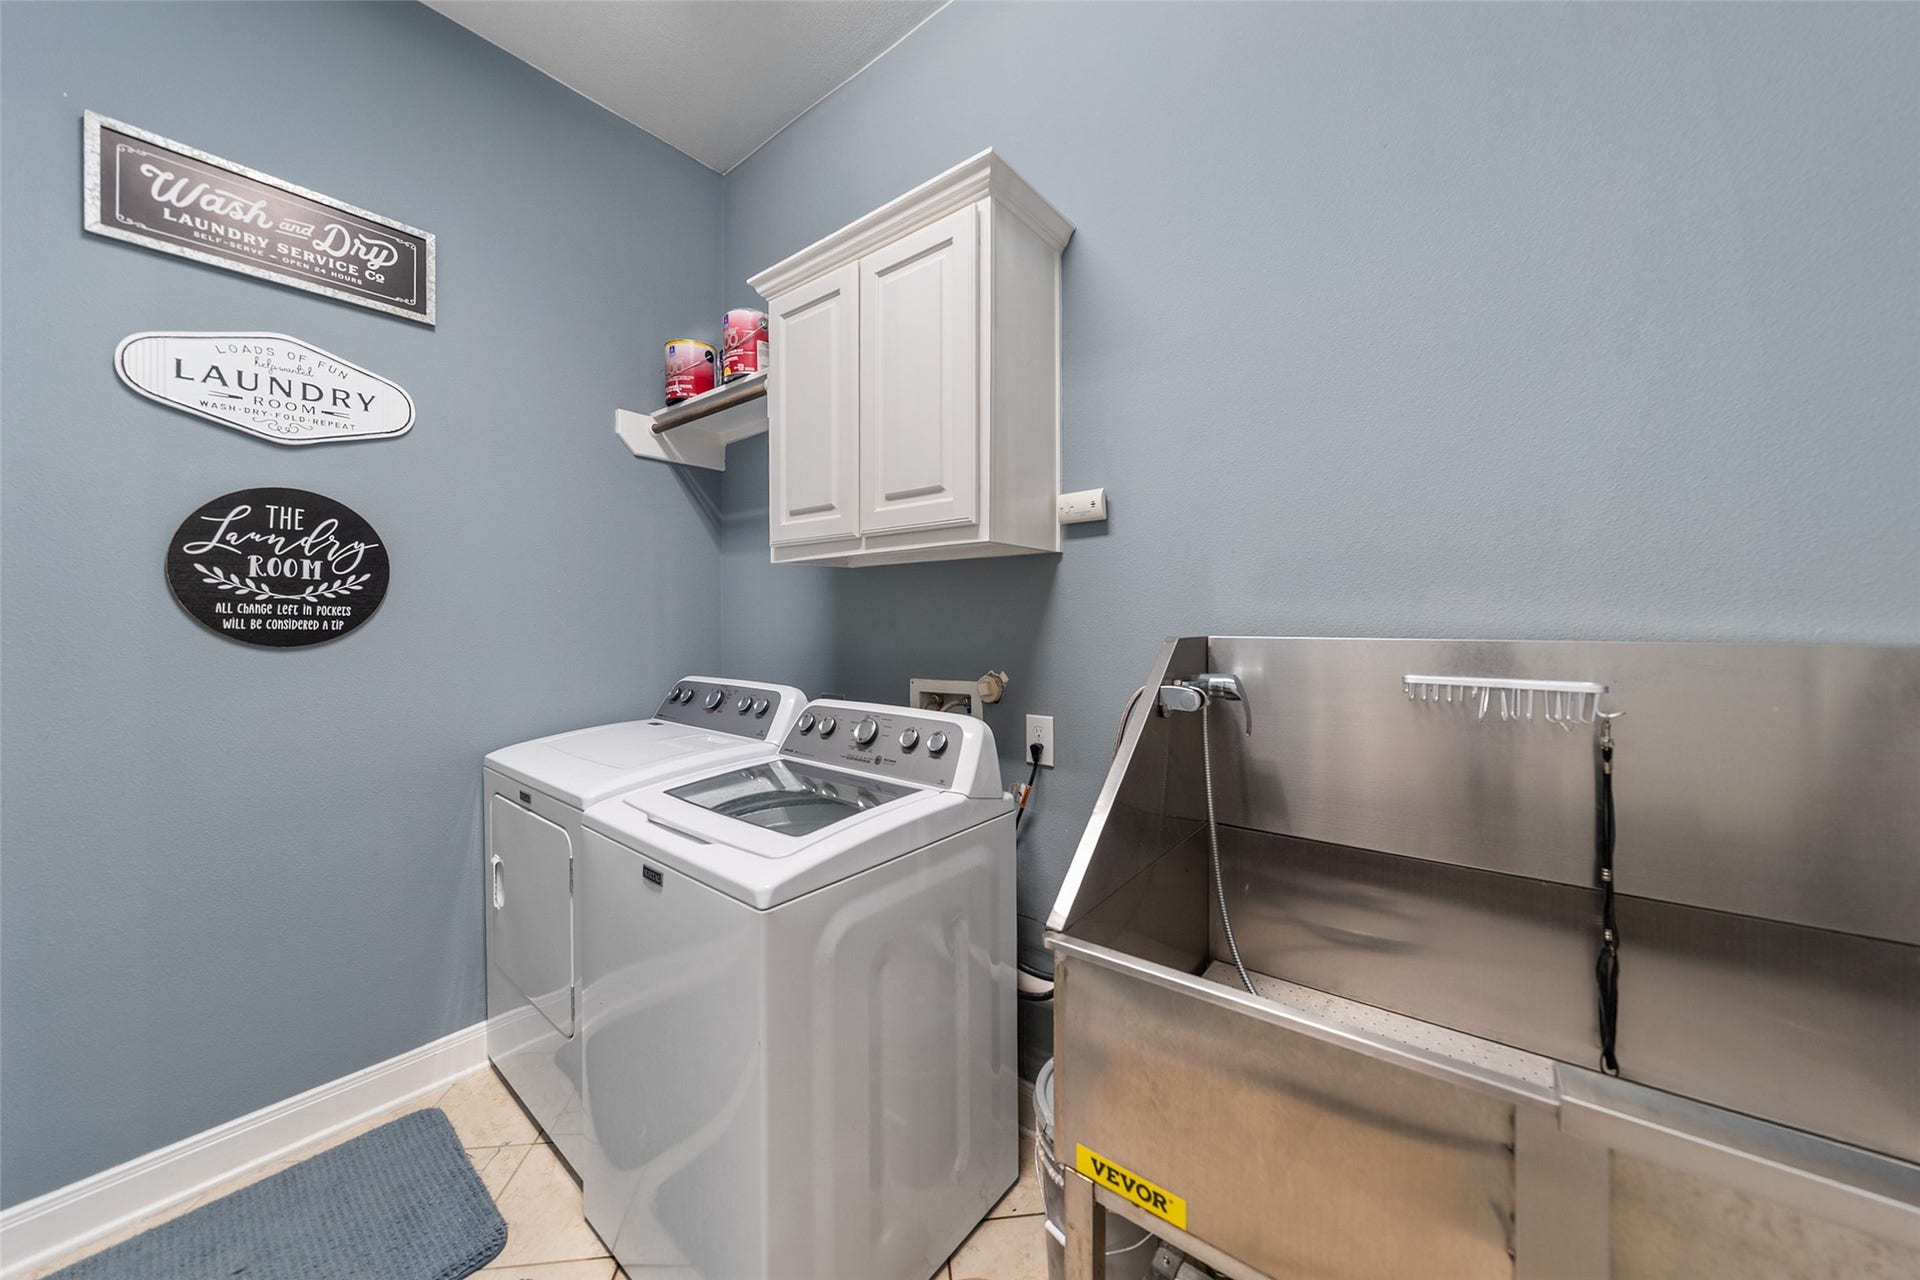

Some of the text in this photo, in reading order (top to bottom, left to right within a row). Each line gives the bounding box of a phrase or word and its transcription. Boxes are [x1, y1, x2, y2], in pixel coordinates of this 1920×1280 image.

[140, 164, 399, 270] Wash and Dry
[163, 207, 269, 249] LAUNDRY
[277, 242, 359, 276] SERVICE
[193, 231, 363, 286] SELF-SERVE OPEN 24 HOURS
[215, 344, 349, 380] LOADS OF FUN
[174, 358, 376, 413] LAUNDRY
[254, 396, 315, 415] ROOM
[183, 504, 379, 575] Laundry
[265, 504, 305, 531] THE
[247, 555, 324, 581] ROOM
[215, 602, 233, 614] ALL
[322, 620, 329, 631] A
[1090, 1157, 1168, 1214] VEVOR
